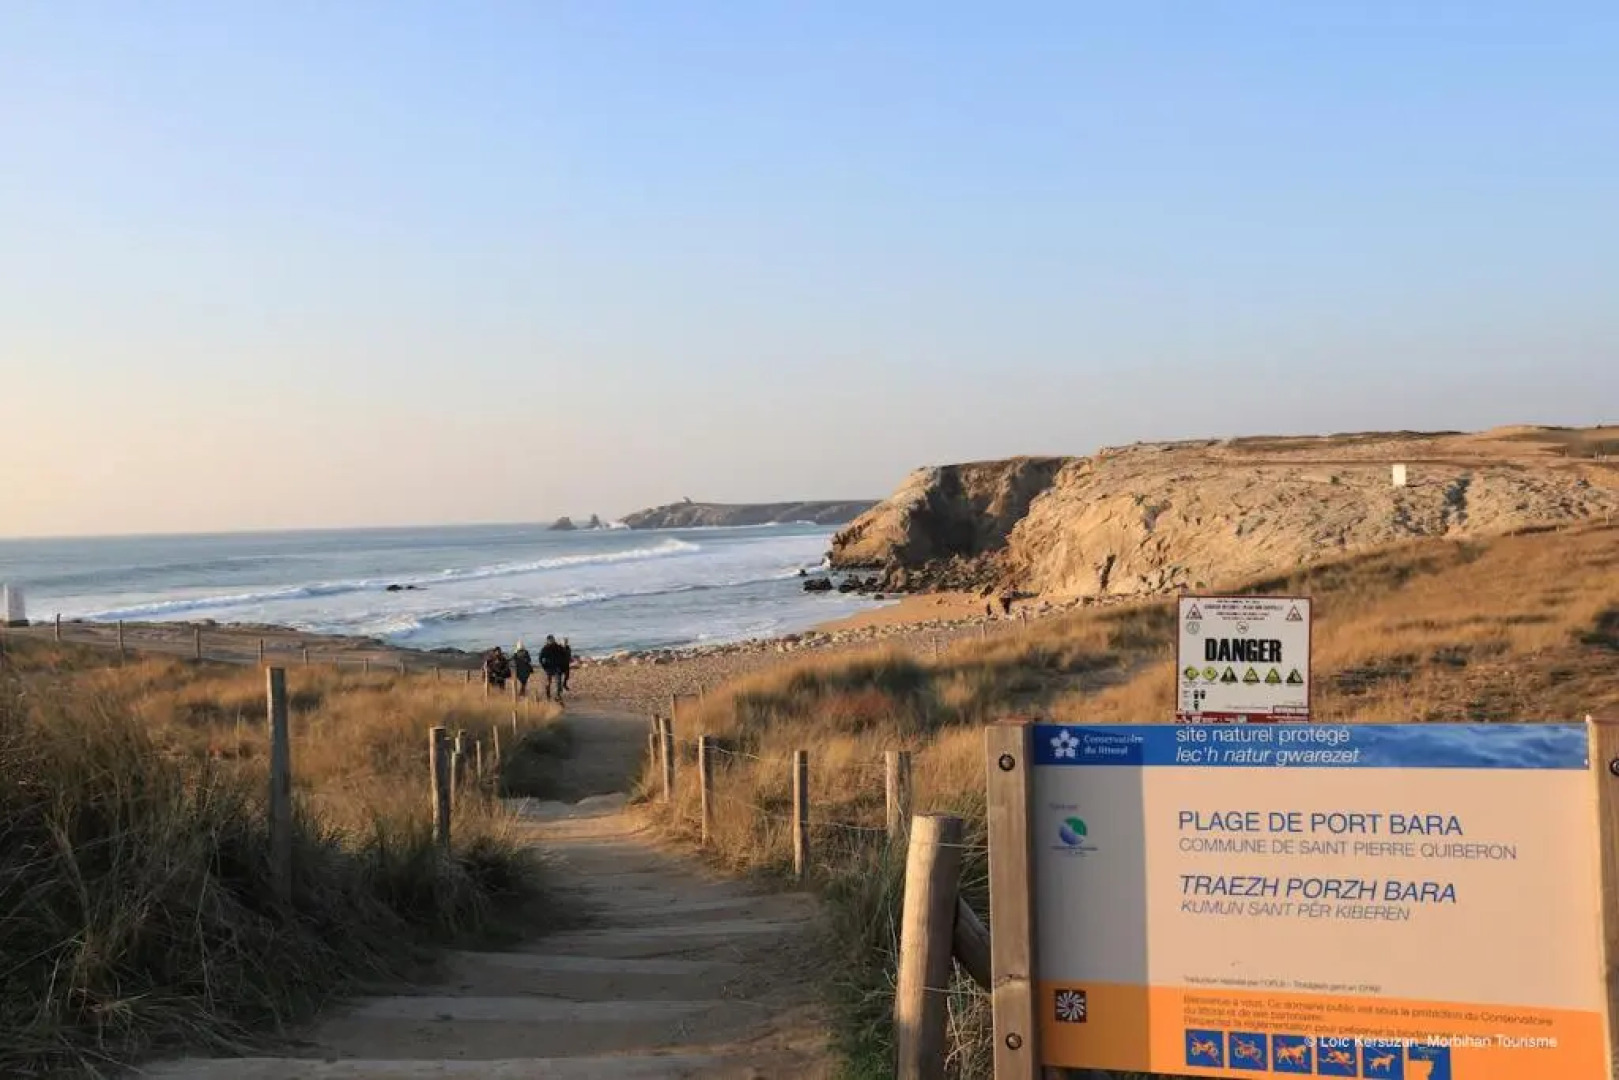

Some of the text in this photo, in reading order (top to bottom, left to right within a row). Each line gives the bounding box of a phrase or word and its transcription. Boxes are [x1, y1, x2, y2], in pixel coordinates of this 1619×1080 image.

[1205, 638, 1282, 662] DANGER
[1176, 726, 1350, 746] site naturel protégé
[1176, 746, 1360, 767] lec'h natur gwarezet
[1179, 811, 1463, 836] PLAGE DE PORT BARA
[1179, 838, 1517, 860] COMMUNE DE SAINT PIERRE QUIBERON
[1181, 876, 1457, 903] TRAEZH PORZH BARA
[1181, 900, 1244, 914] KUMUN
[1248, 902, 1293, 916] SANT
[1336, 904, 1410, 920] KIBEREN
